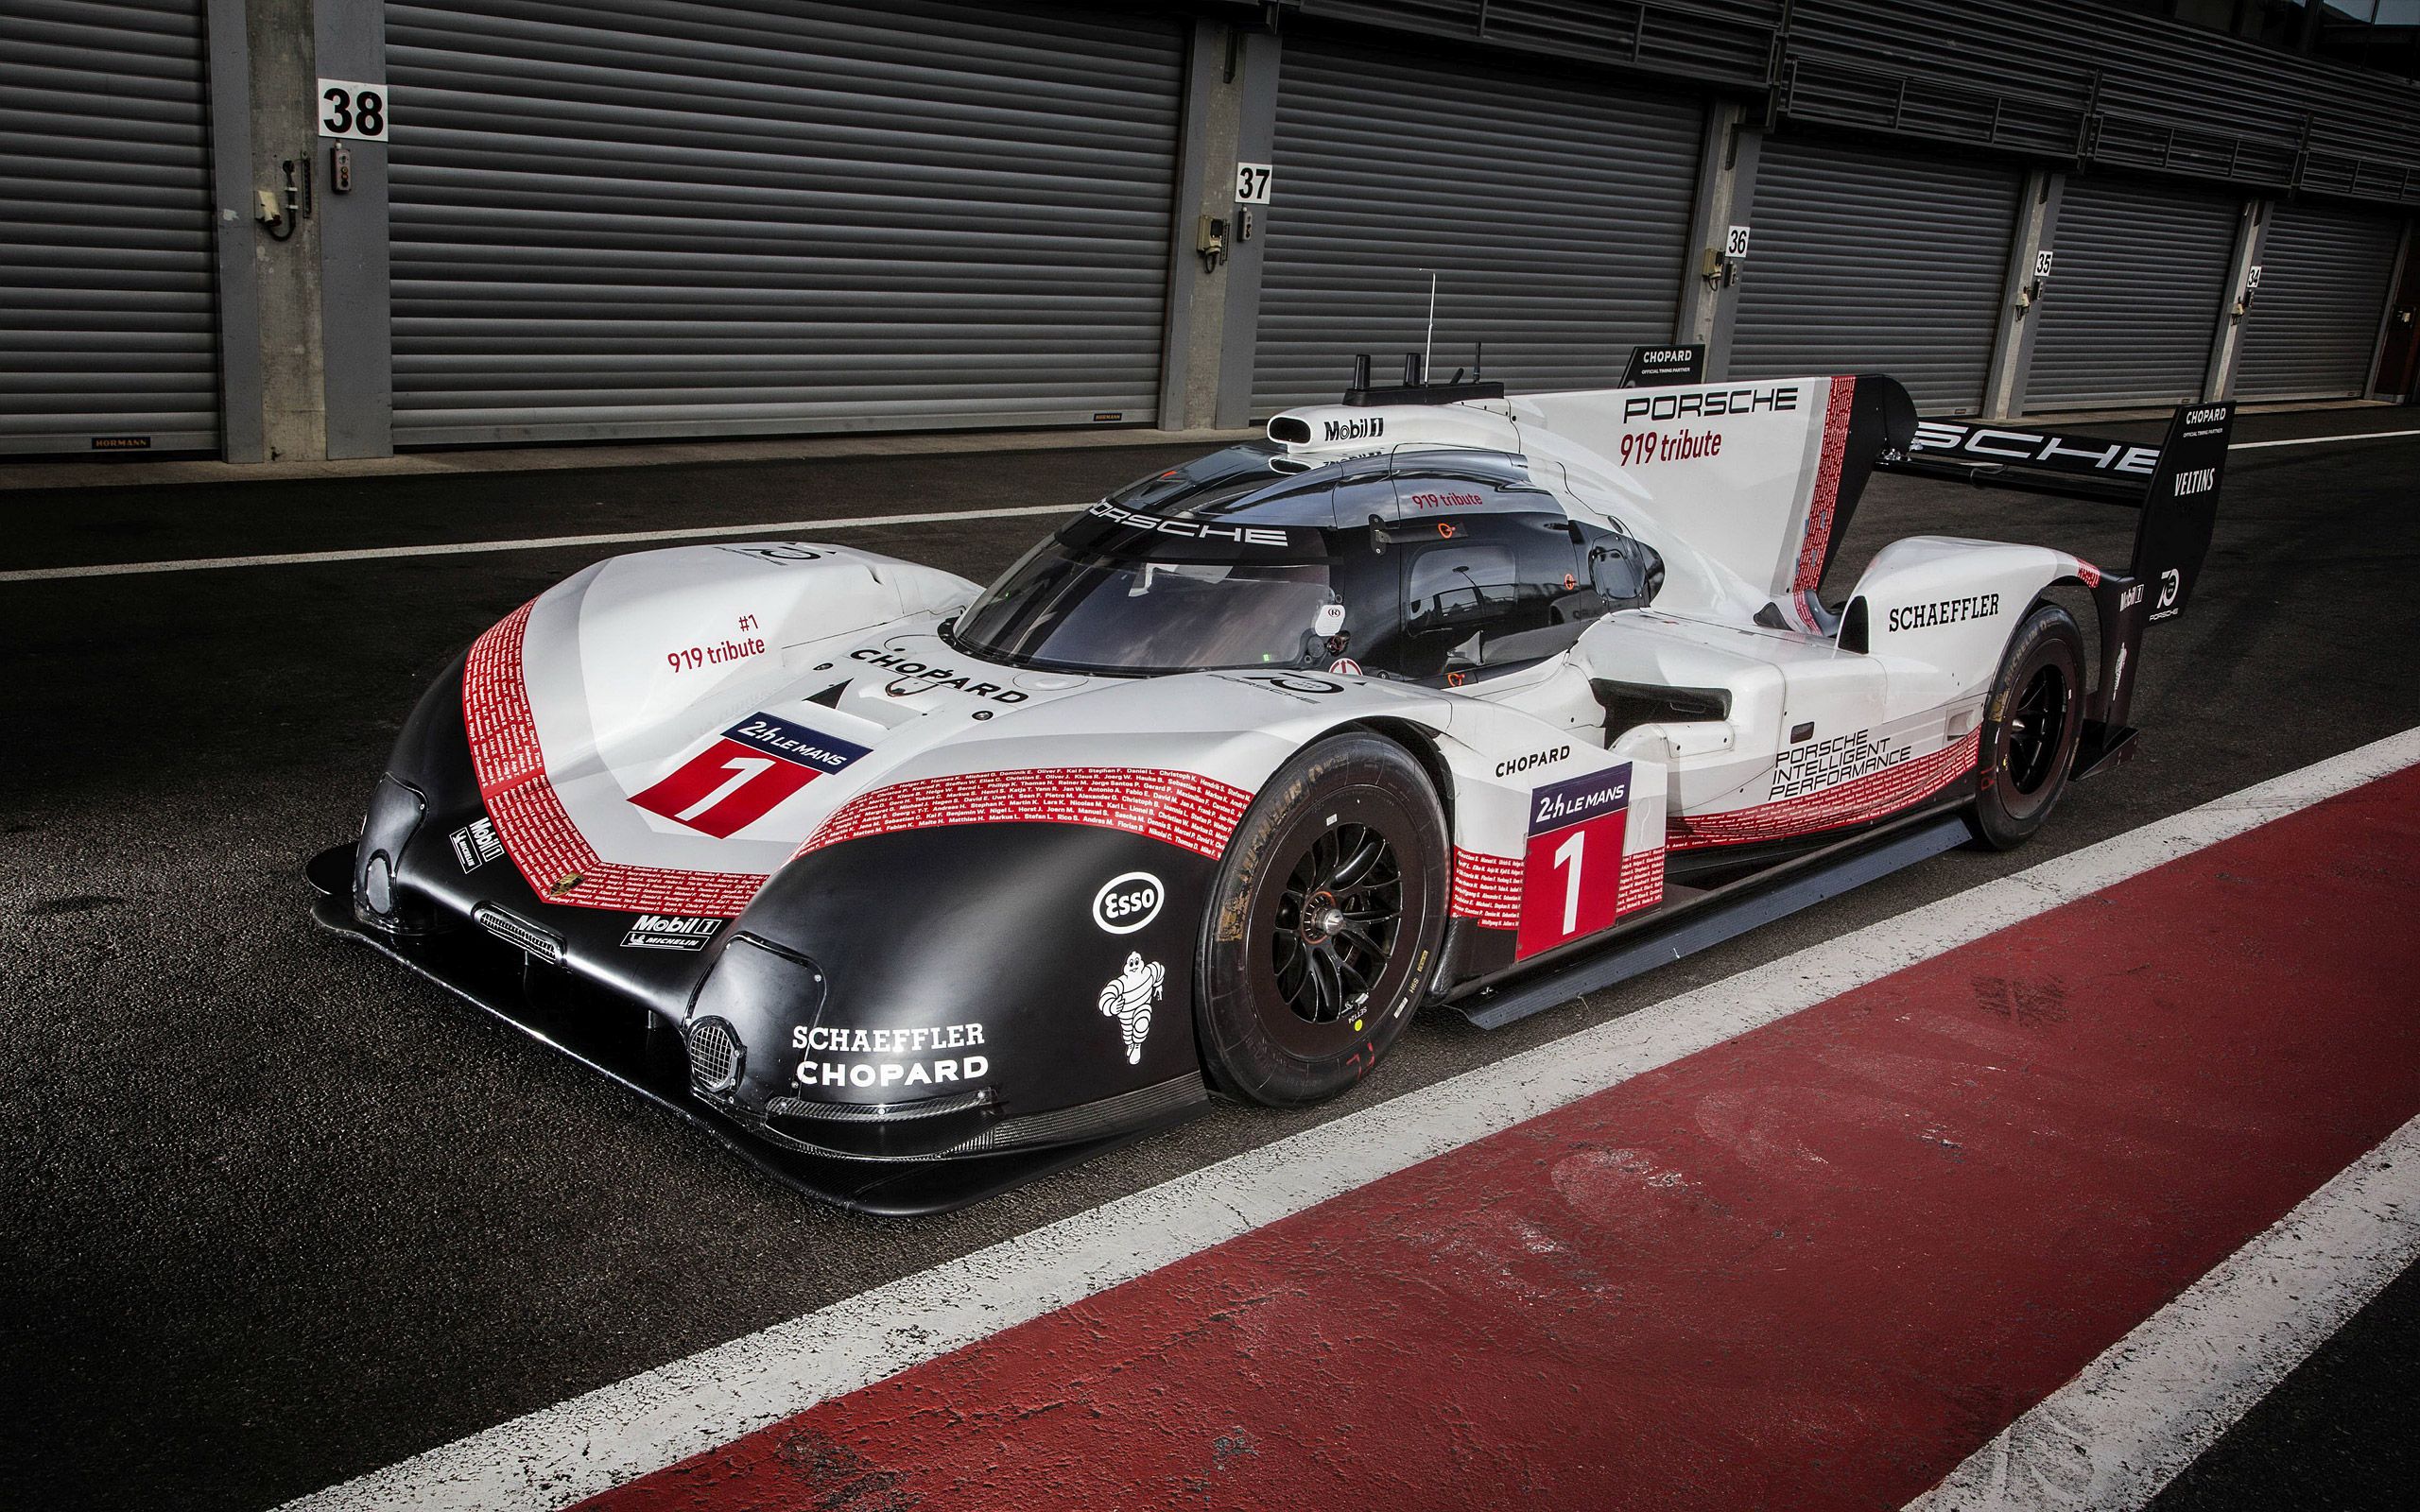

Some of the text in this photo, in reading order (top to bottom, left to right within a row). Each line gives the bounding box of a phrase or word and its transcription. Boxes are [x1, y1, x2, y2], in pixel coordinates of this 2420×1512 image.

[323, 88, 384, 136] 38
[1238, 167, 1270, 199] 37
[1728, 230, 1747, 254] 36
[2037, 253, 2051, 274] 35
[2248, 268, 2260, 286] 34
[1643, 350, 1692, 363] CHOPARD
[1623, 387, 1799, 424] PORSCHE
[2186, 407, 2226, 425] CHOPARD
[1323, 418, 1368, 441] Mobil
[1620, 428, 1722, 467] 919 tribute
[2174, 468, 2216, 497] VELTINS
[1411, 491, 1482, 510] 919 tribute
[738, 614, 759, 632] #1
[1889, 593, 1999, 632] SCHAEFFLER
[2149, 608, 2179, 622] PORSCHE
[667, 637, 766, 673] 919 tribute
[851, 649, 1028, 704] CHOPARD
[770, 736, 798, 749] LE
[791, 744, 847, 766] MANS
[1495, 745, 1571, 778] CHOPARD
[1772, 737, 1891, 785] INTELLIGENT
[1774, 729, 1869, 767] PORSCHE
[673, 757, 777, 822] 1
[1767, 746, 1911, 801] PERFORMANCE
[1536, 783, 1625, 823] 24h LE MANS
[469, 816, 500, 852] Mobil
[1553, 830, 1585, 936] 1
[631, 915, 700, 934] Mobil
[646, 936, 700, 946] MICHELIN
[792, 1022, 985, 1053] SCHAEFFLER
[796, 1056, 989, 1088] CHOPARD
